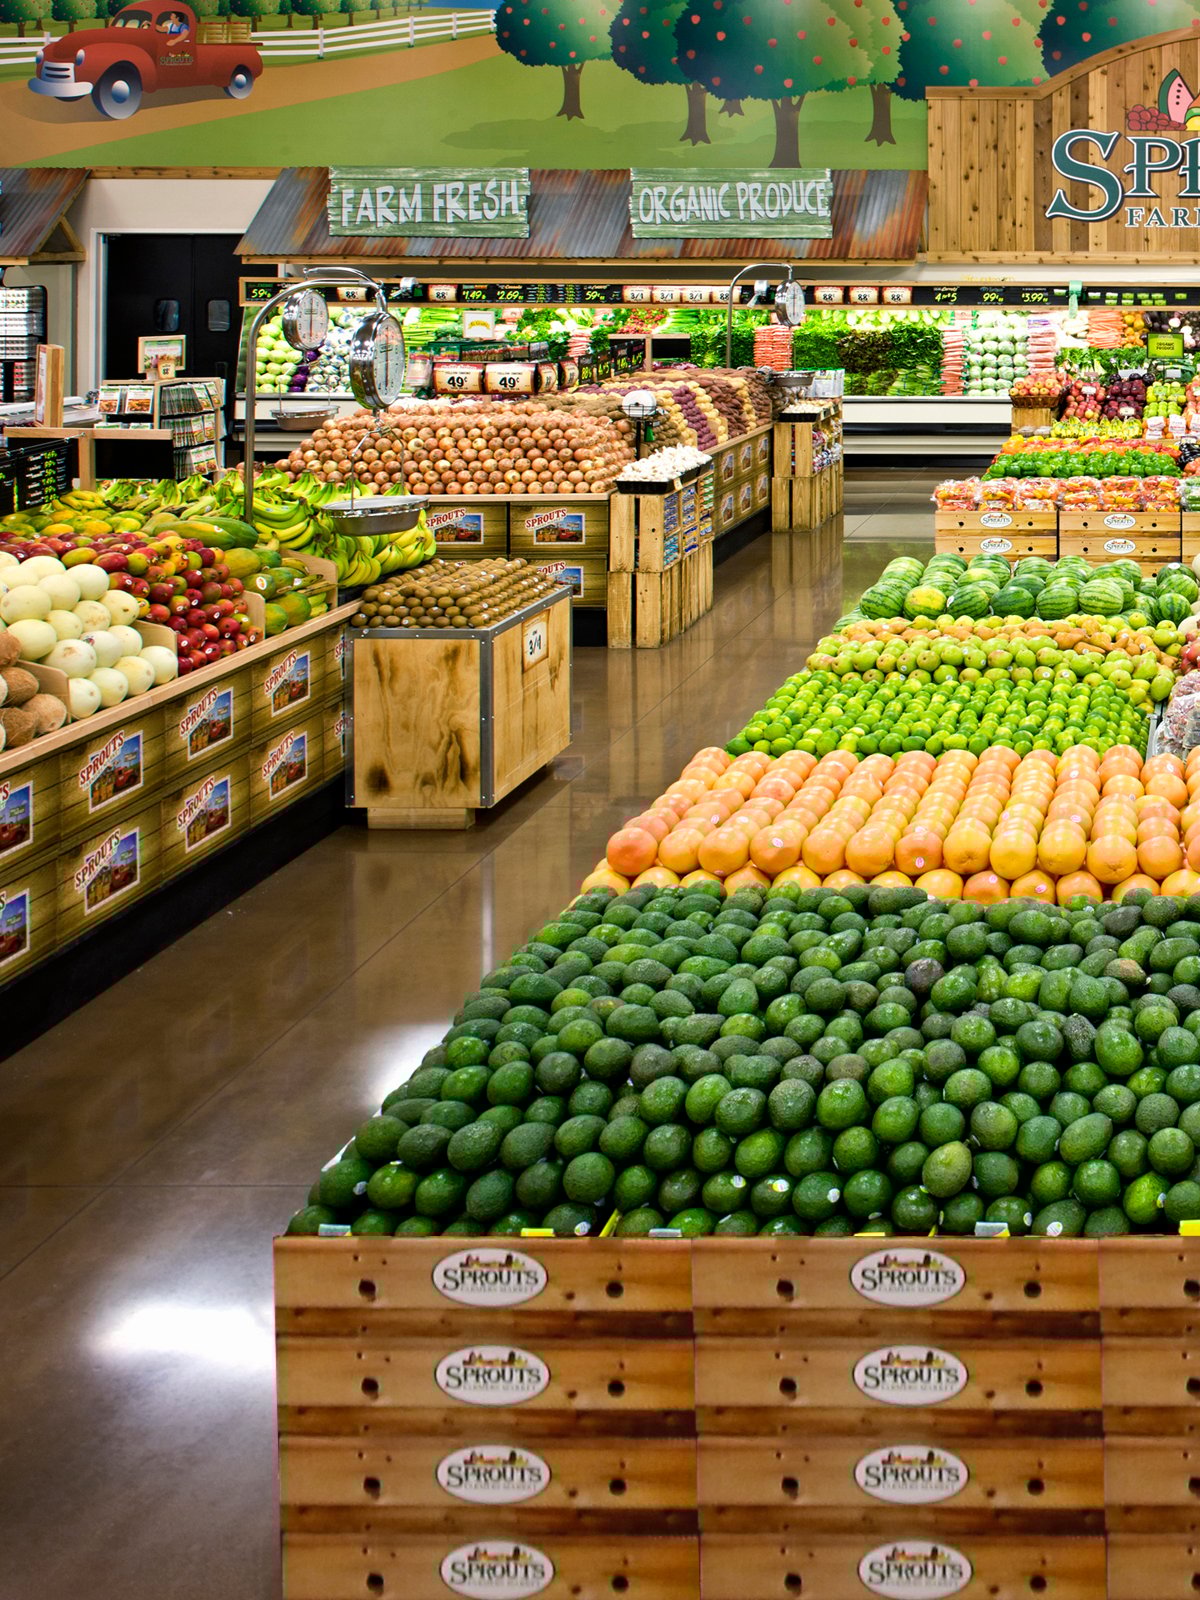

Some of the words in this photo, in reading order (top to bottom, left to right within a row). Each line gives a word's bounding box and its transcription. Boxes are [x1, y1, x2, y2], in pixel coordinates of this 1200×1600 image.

[342, 184, 423, 228] FARM
[431, 179, 521, 224] FRESH
[637, 183, 732, 225] ORGANIC
[737, 181, 829, 222] PRODUCE
[447, 376, 468, 388] 49¢
[499, 376, 520, 389] 49¢
[426, 508, 466, 527] SPROUTS
[526, 508, 567, 528] SPROUTS
[265, 652, 297, 694] SPROUTS
[181, 688, 217, 735] SPROUTS
[80, 732, 124, 785] SPROUTS
[262, 733, 294, 778] SPROUTS
[177, 778, 214, 828] SPROUTS
[75, 831, 120, 888] SPROUTS
[443, 1268, 538, 1291] SPROUTS
[861, 1268, 956, 1291] SPROUTS
[446, 1366, 541, 1389] SPROUTS
[864, 1366, 959, 1389] SPROUTS
[447, 1465, 542, 1488] SPROUTS
[865, 1465, 960, 1488] SPROUTS
[450, 1561, 545, 1584] SPROUTS
[868, 1561, 963, 1584] SPROUTS
